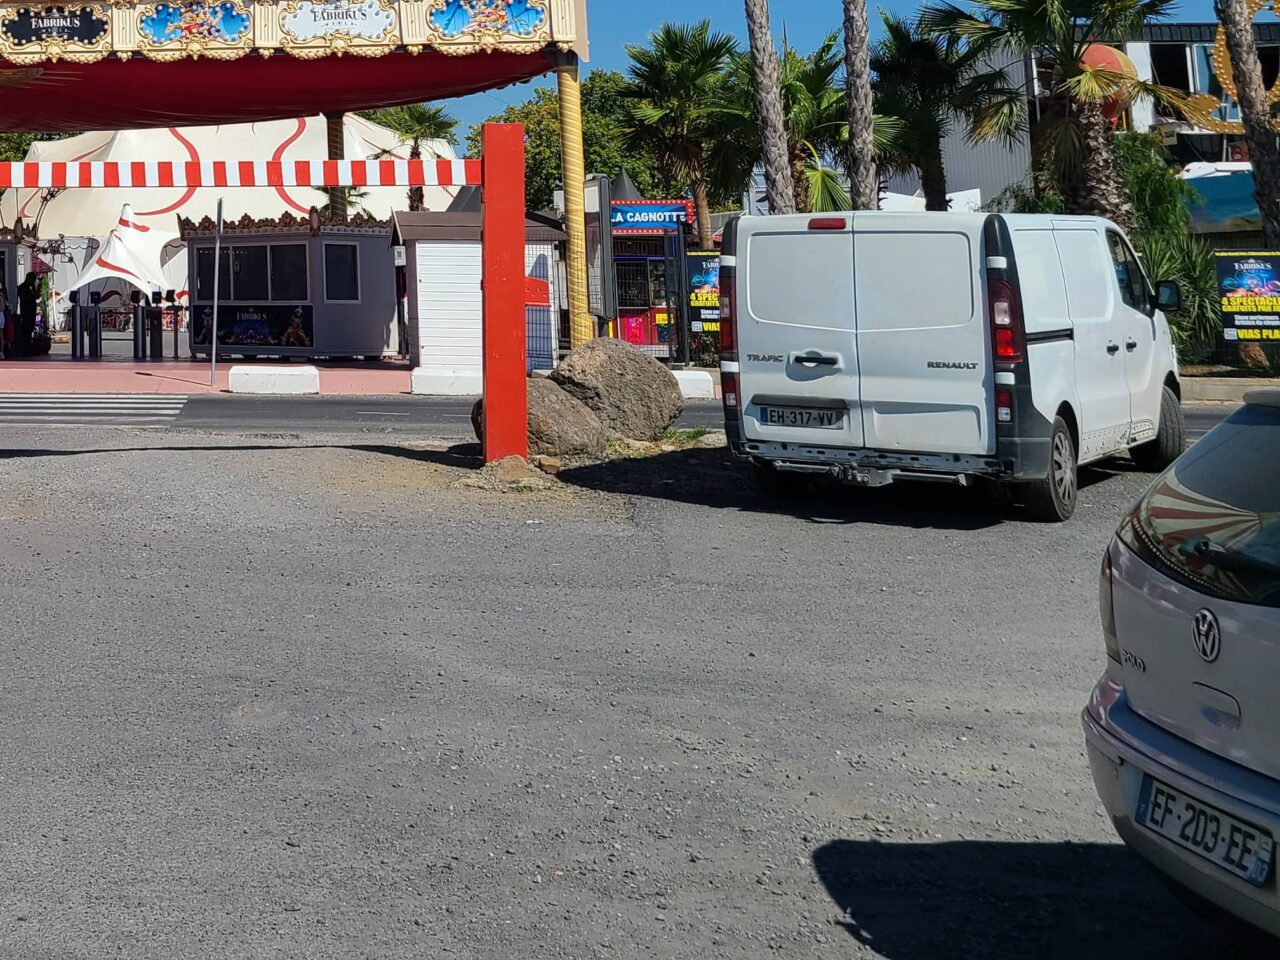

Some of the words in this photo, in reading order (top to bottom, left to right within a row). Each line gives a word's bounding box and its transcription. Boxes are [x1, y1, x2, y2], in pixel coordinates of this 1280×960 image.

[313, 9, 367, 22] FABRIKUS
[31, 17, 80, 28] FABRIKUS
[626, 212, 687, 222] CAGNOTTE
[1237, 329, 1261, 339] VIAS
[747, 354, 784, 362] TRAFIC
[927, 361, 978, 370] RENAULT
[1121, 649, 1146, 672] POLO
